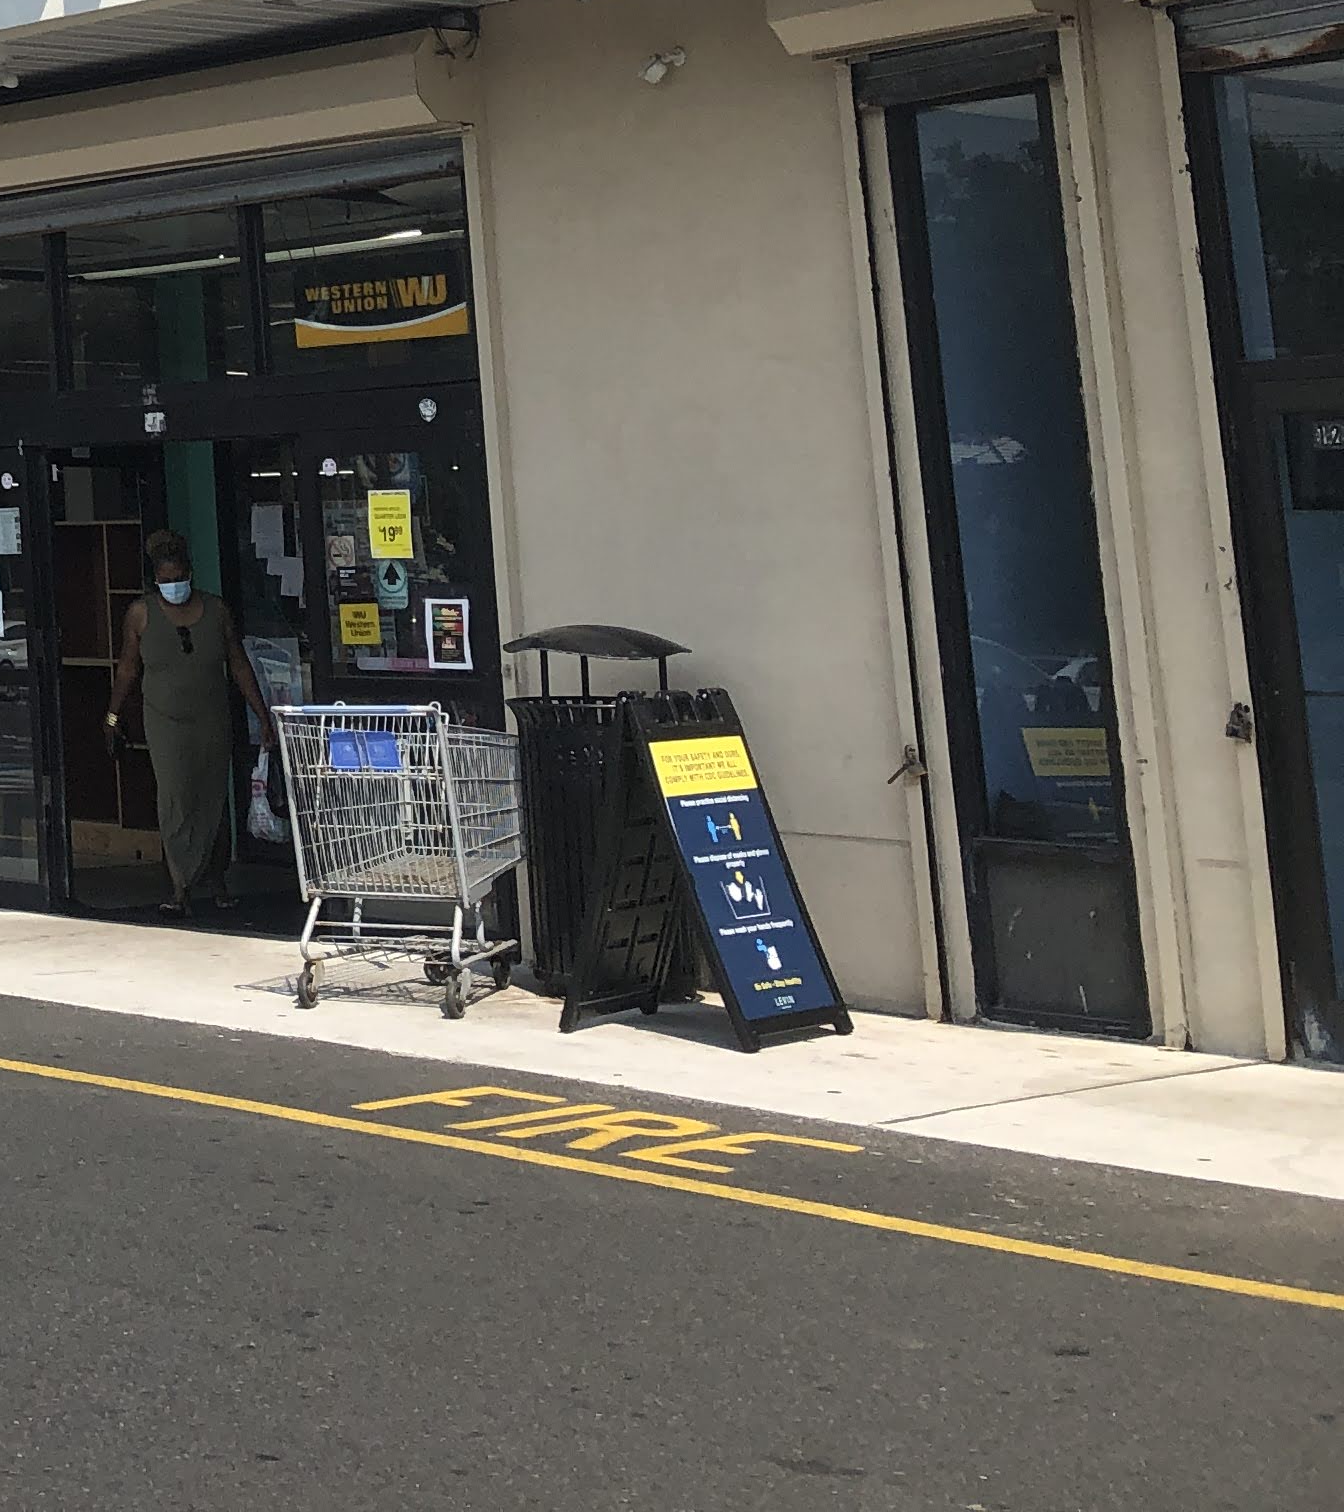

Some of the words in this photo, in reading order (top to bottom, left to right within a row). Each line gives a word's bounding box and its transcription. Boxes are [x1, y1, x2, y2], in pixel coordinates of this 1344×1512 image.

[305, 280, 387, 302] WESTERN
[331, 295, 388, 314] UNION
[397, 274, 447, 308] WU
[352, 1085, 865, 1174] FIRE
